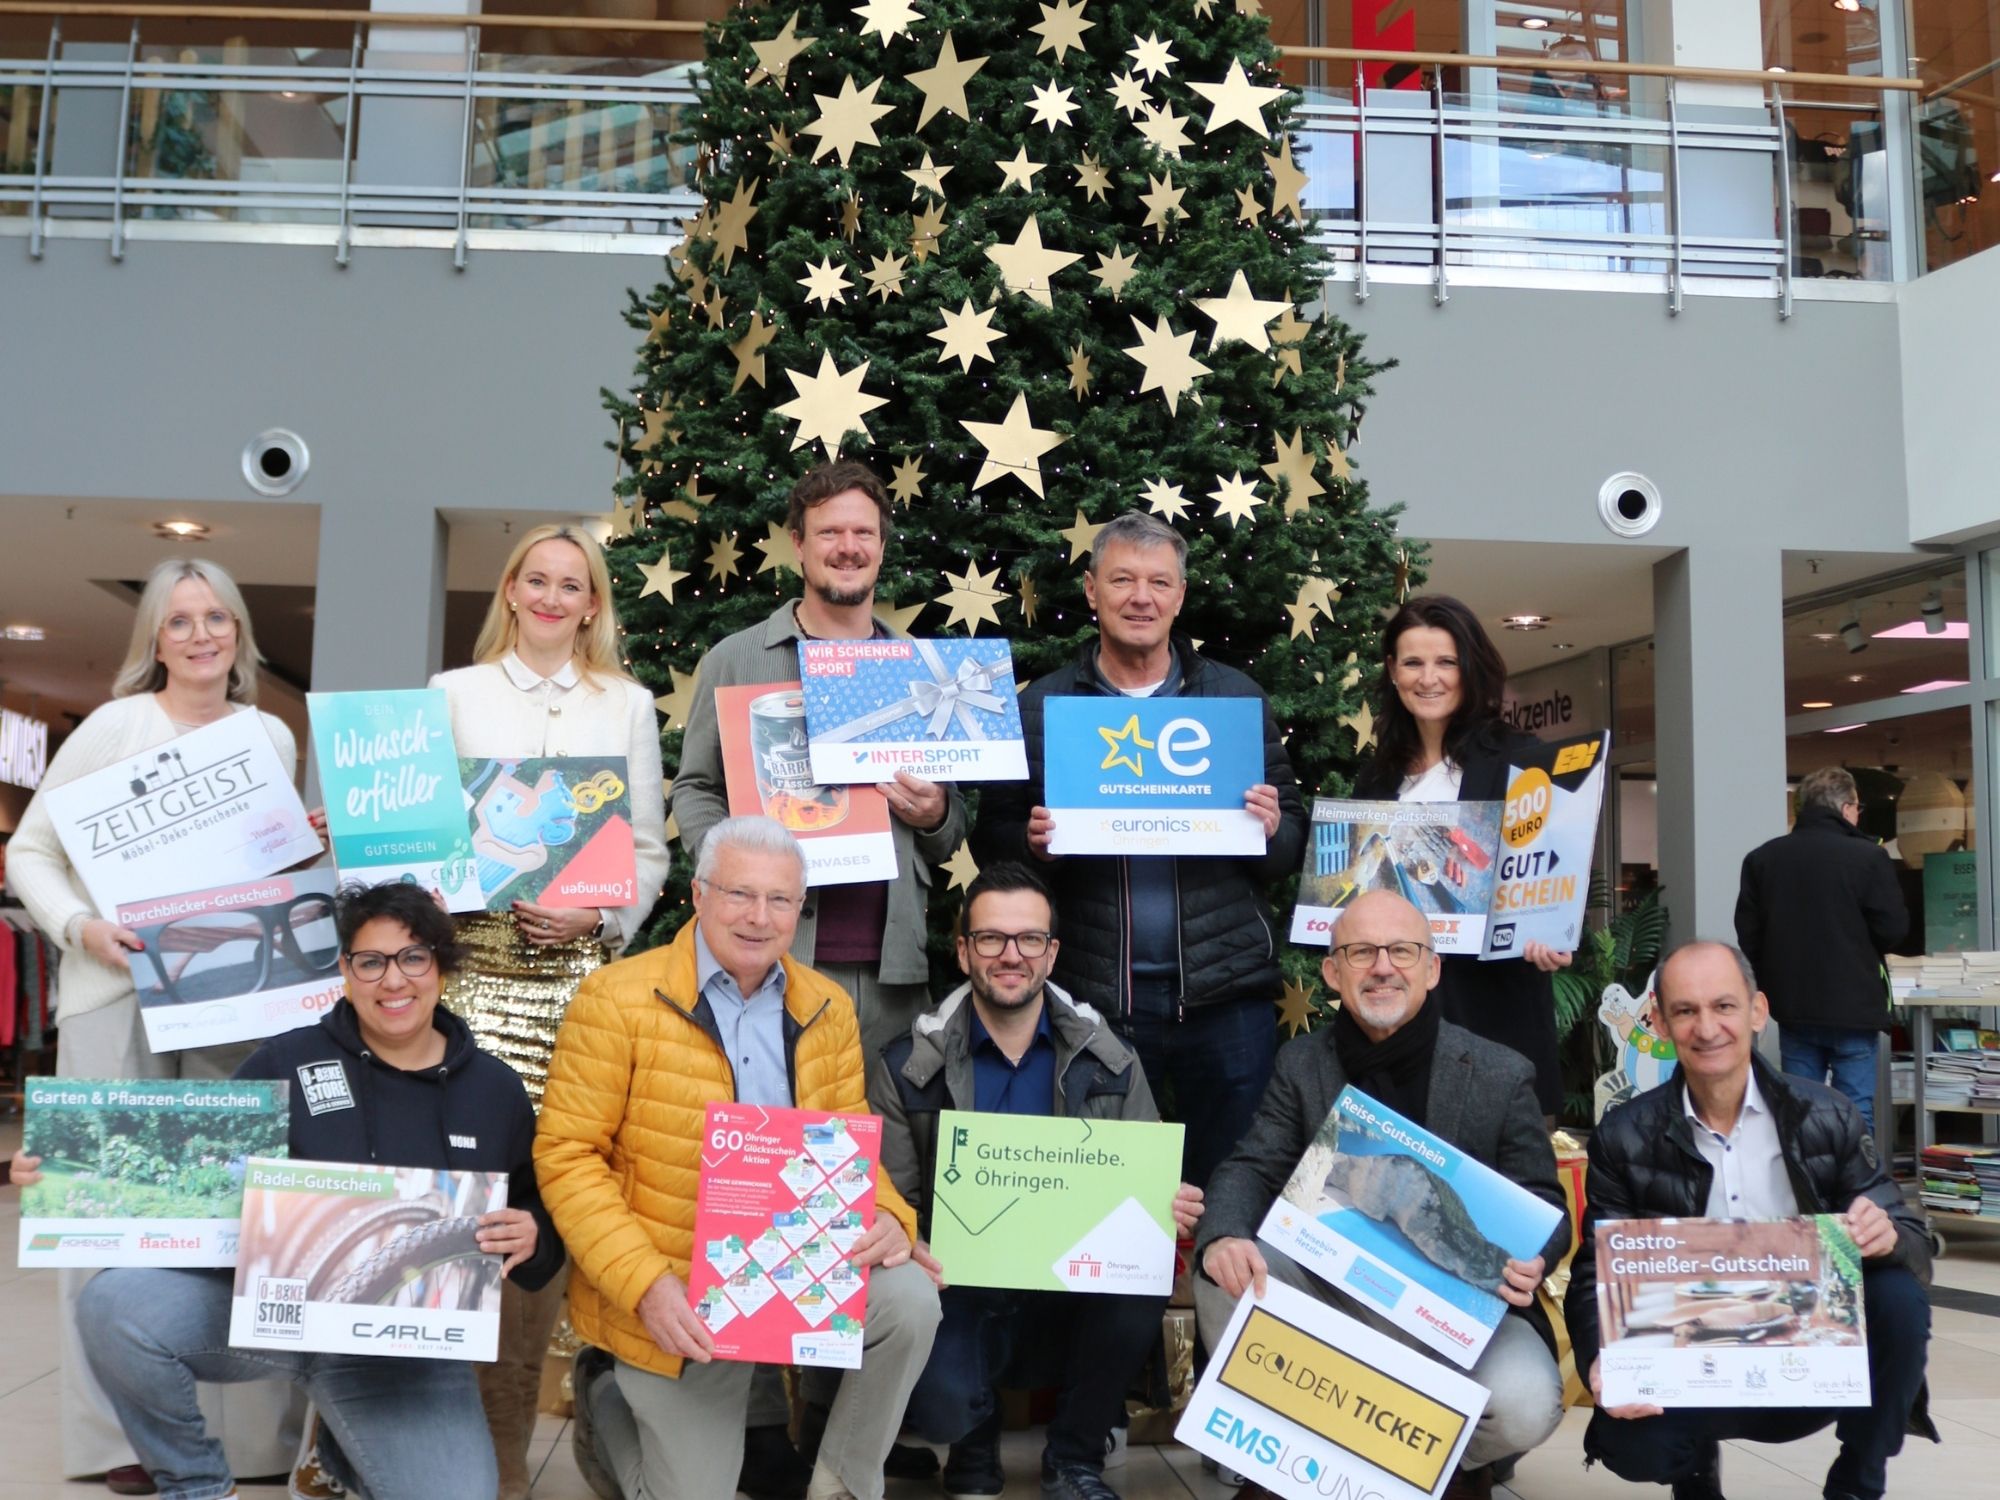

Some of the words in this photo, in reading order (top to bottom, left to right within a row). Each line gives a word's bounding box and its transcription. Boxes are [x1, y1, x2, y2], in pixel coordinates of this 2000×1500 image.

[808, 646, 834, 658] WIR
[837, 646, 910, 658] SCHENKEN
[809, 661, 854, 674] SPORT
[364, 704, 394, 716] DEIN
[334, 709, 443, 768] Wunsch-
[871, 748, 981, 763] INTERSPORT
[900, 764, 953, 775] GRABERT
[347, 764, 442, 822] erfüller
[1099, 784, 1212, 795] GUTSCHEINKARTE
[82, 757, 253, 851] ZEITGEIST
[1505, 786, 1547, 828] 500
[1316, 806, 1449, 823] Heimwerken-Gutschein
[1511, 816, 1543, 842] EURO
[364, 841, 437, 857] GUTSCHEIN
[431, 865, 476, 881] CENTER
[1500, 851, 1545, 882] GUT
[560, 881, 623, 898] Öhringen
[1494, 874, 1577, 912] SCHEIN
[121, 886, 283, 925] Durchblicker-Gutschein
[1430, 919, 1461, 934] BI
[31, 1090, 87, 1105] Garten
[91, 1091, 104, 1106] &
[108, 1090, 260, 1108] Pflanzen-Gutschein
[307, 1081, 347, 1103] STORE
[711, 1128, 743, 1151] 60
[744, 1132, 781, 1145] Öhringer
[1340, 1095, 1447, 1168] Reise-Gutschein
[742, 1155, 770, 1165] Aktion
[743, 1144, 797, 1156] Glücksschein
[976, 1142, 1126, 1167] Gutscheinliebe.
[252, 1171, 382, 1193] Radel-Gutschein
[974, 1166, 1070, 1194] Öhringen.
[139, 1237, 201, 1249] Hachtel
[1610, 1234, 1687, 1250] Gastro-
[1611, 1255, 1810, 1274] Genießer-Gutschein
[258, 1302, 303, 1325] STORE
[352, 1322, 466, 1343] CARLE
[1415, 1303, 1476, 1347] Herbold
[1245, 1342, 1349, 1409] GOLDEN
[1353, 1395, 1442, 1456] TICKET
